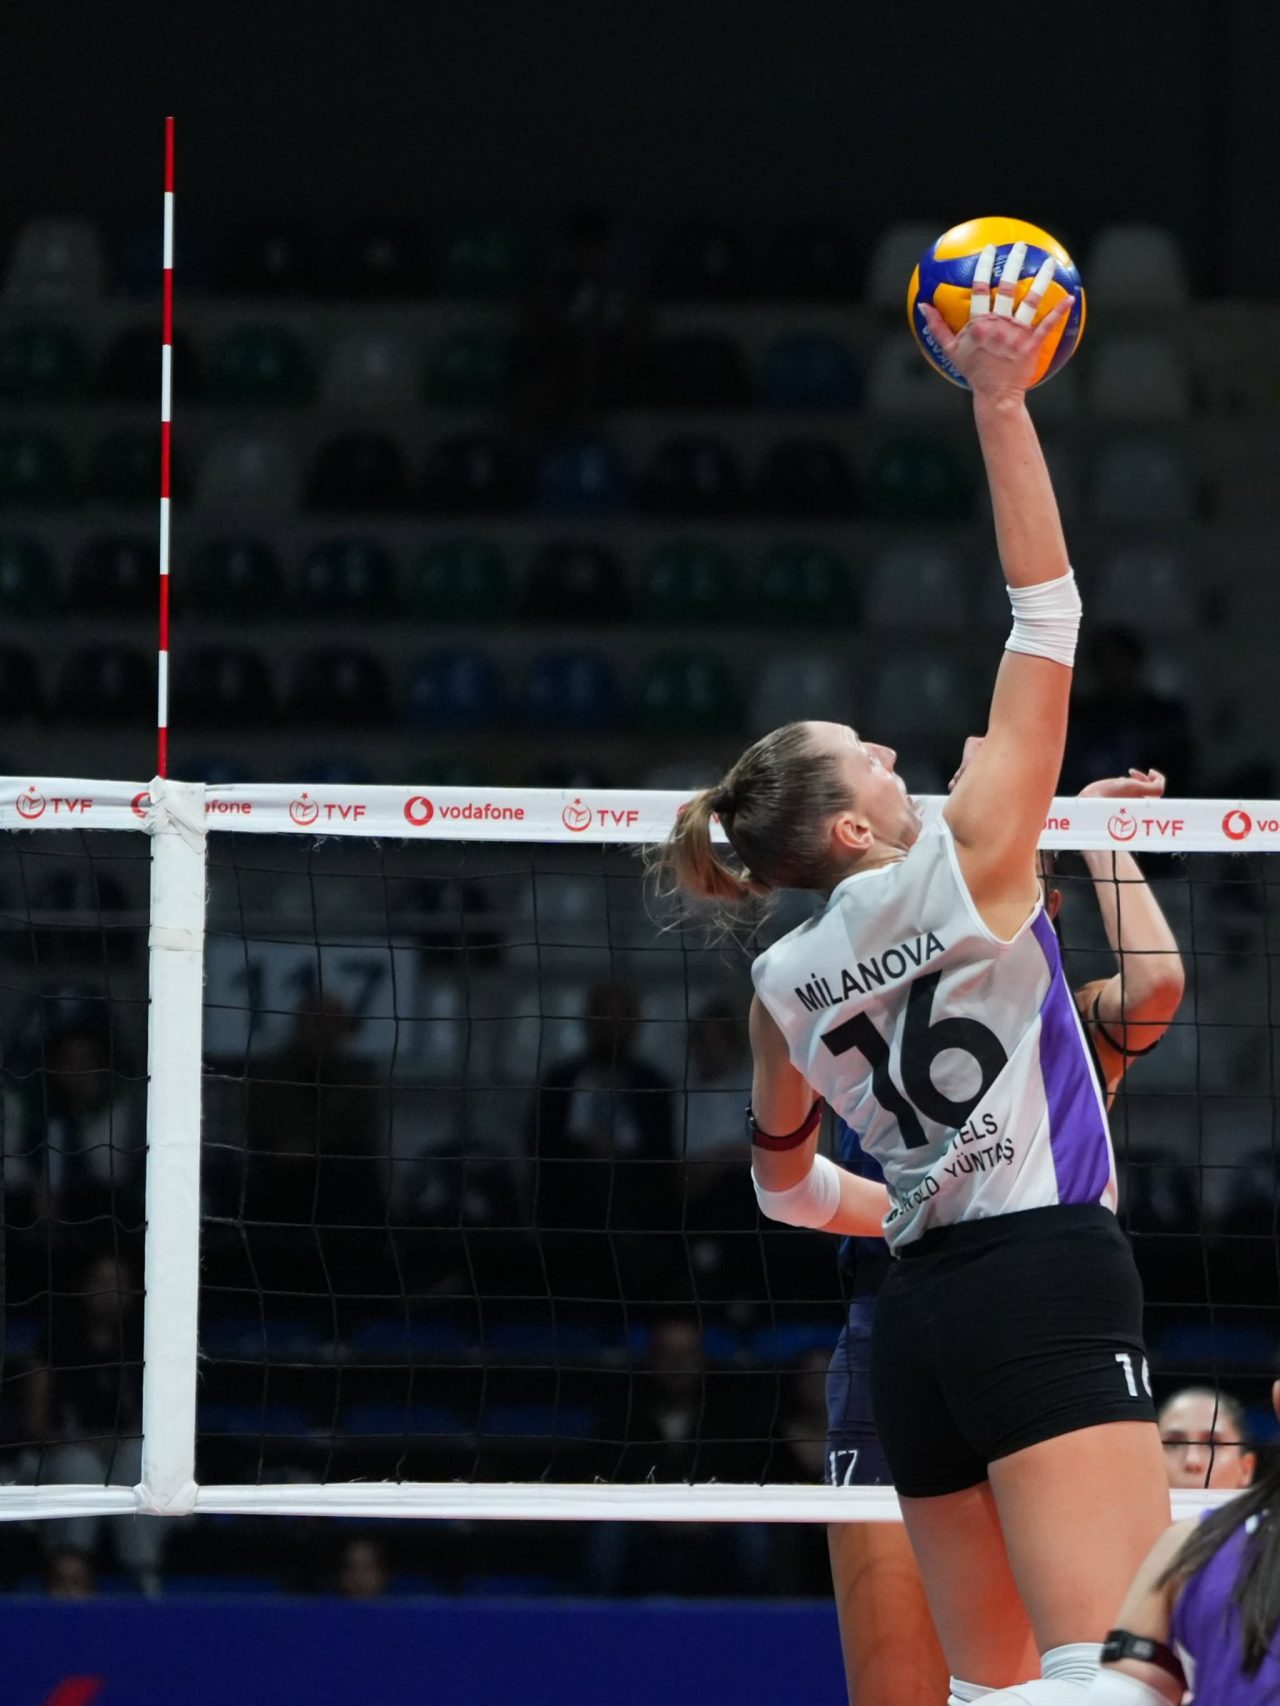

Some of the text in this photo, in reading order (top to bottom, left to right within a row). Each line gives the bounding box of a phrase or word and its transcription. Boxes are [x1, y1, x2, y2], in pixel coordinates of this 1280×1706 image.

[52, 798, 92, 814] TVF
[324, 803, 366, 818] TVF
[439, 802, 525, 820] vodafone
[597, 808, 640, 825] TVF
[1142, 818, 1184, 836] TVF
[794, 932, 946, 1012] MİLANOVA
[820, 969, 1009, 1150] 16
[944, 1137, 1015, 1179] YÜNTAŞ
